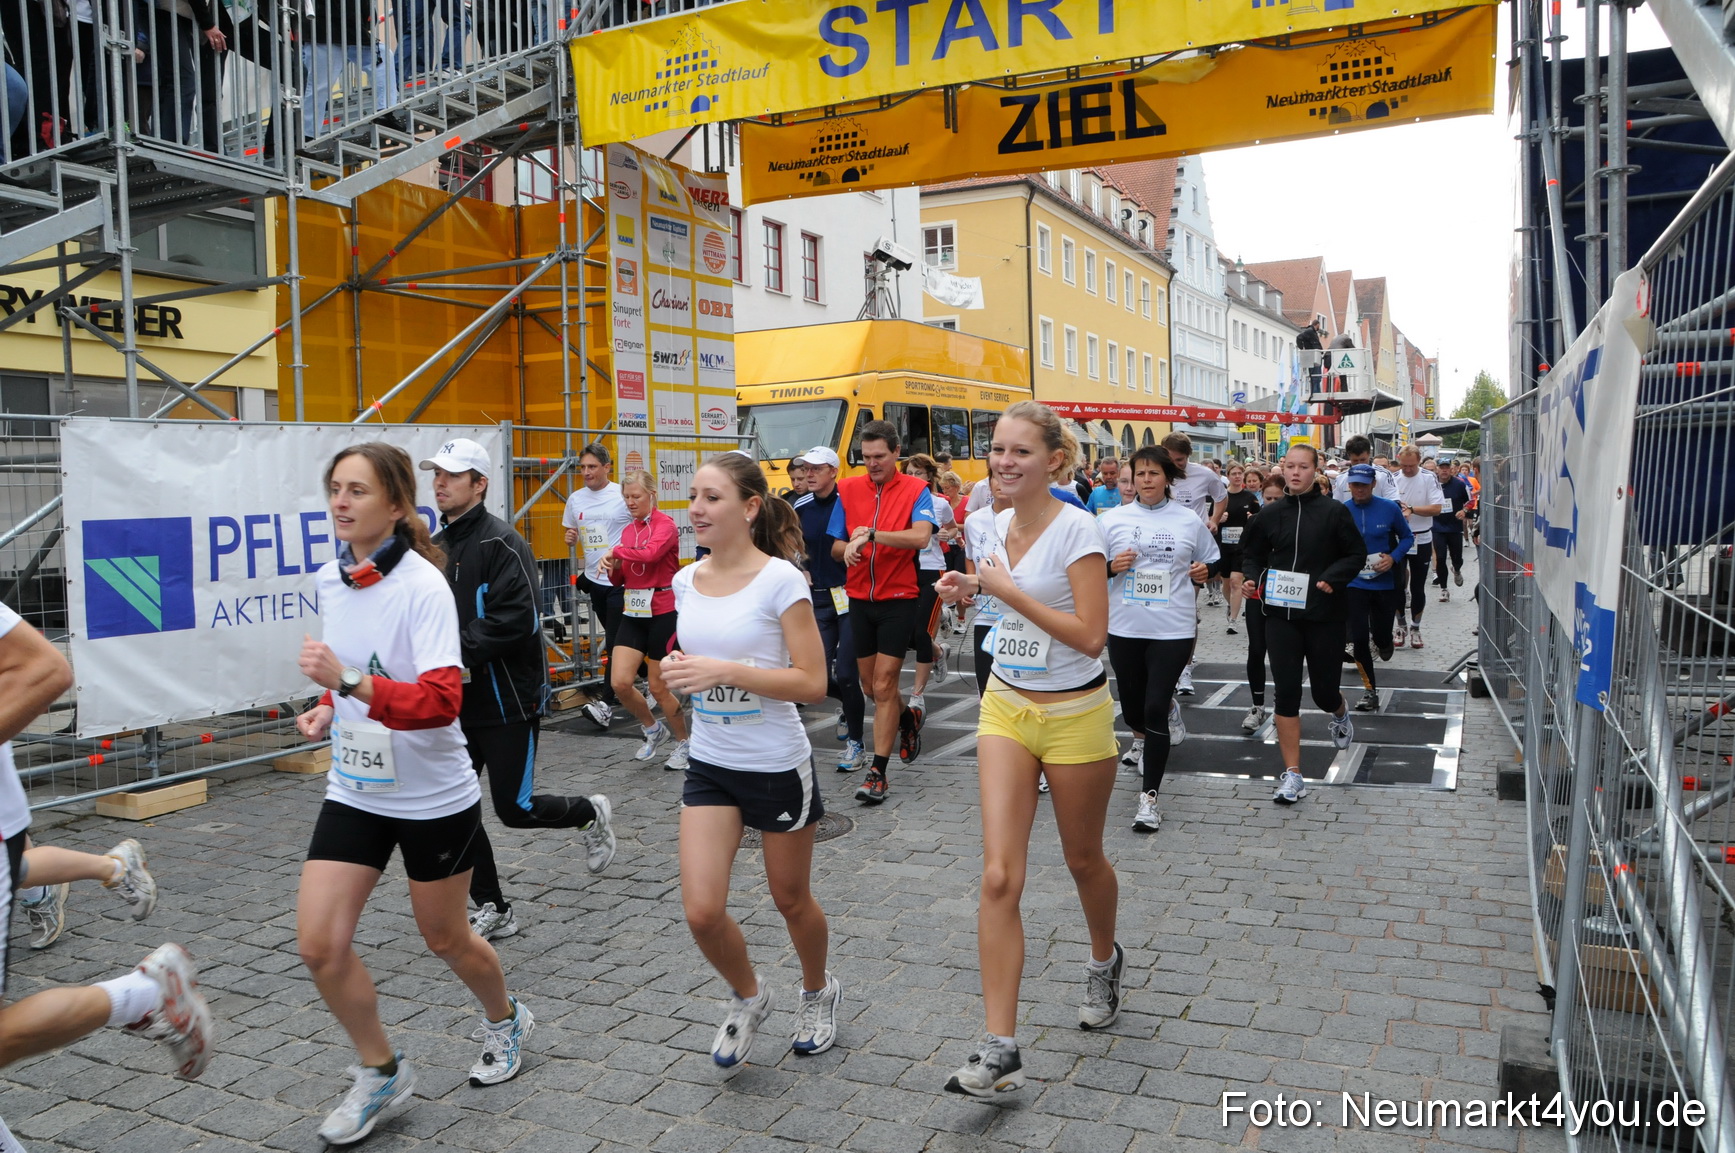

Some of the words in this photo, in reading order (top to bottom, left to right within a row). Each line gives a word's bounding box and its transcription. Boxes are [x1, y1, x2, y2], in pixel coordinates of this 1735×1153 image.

[610, 79, 693, 106] Neumarkter
[697, 63, 770, 88] Stadtlauf
[1266, 85, 1367, 109] Neumarkter
[1372, 67, 1452, 94] Stadtlauf
[998, 79, 1167, 154] ZIEL
[768, 154, 844, 172] Neumarkter
[848, 143, 910, 162] Stadtlauf
[688, 187, 729, 206] MERZ
[613, 302, 642, 317] Sinupret
[698, 299, 733, 318] OBI
[53, 293, 184, 340] WEBER
[613, 316, 631, 328] forte
[699, 353, 724, 367] MCM
[770, 385, 825, 399] TIMING
[980, 391, 993, 401] EVENT
[993, 392, 1010, 403] SERVICE
[618, 420, 647, 429] HACKNER
[660, 460, 694, 477] Sinupret
[661, 478, 680, 491] forte
[588, 535, 603, 544] 823
[1136, 572, 1162, 580] Christine
[1136, 583, 1163, 594] 3091
[1276, 584, 1303, 596] 2487
[631, 598, 646, 608] 606
[1000, 619, 1024, 632] Nicole
[998, 637, 1040, 657] 2086
[707, 686, 750, 702] 2072
[342, 746, 384, 769] 2754
